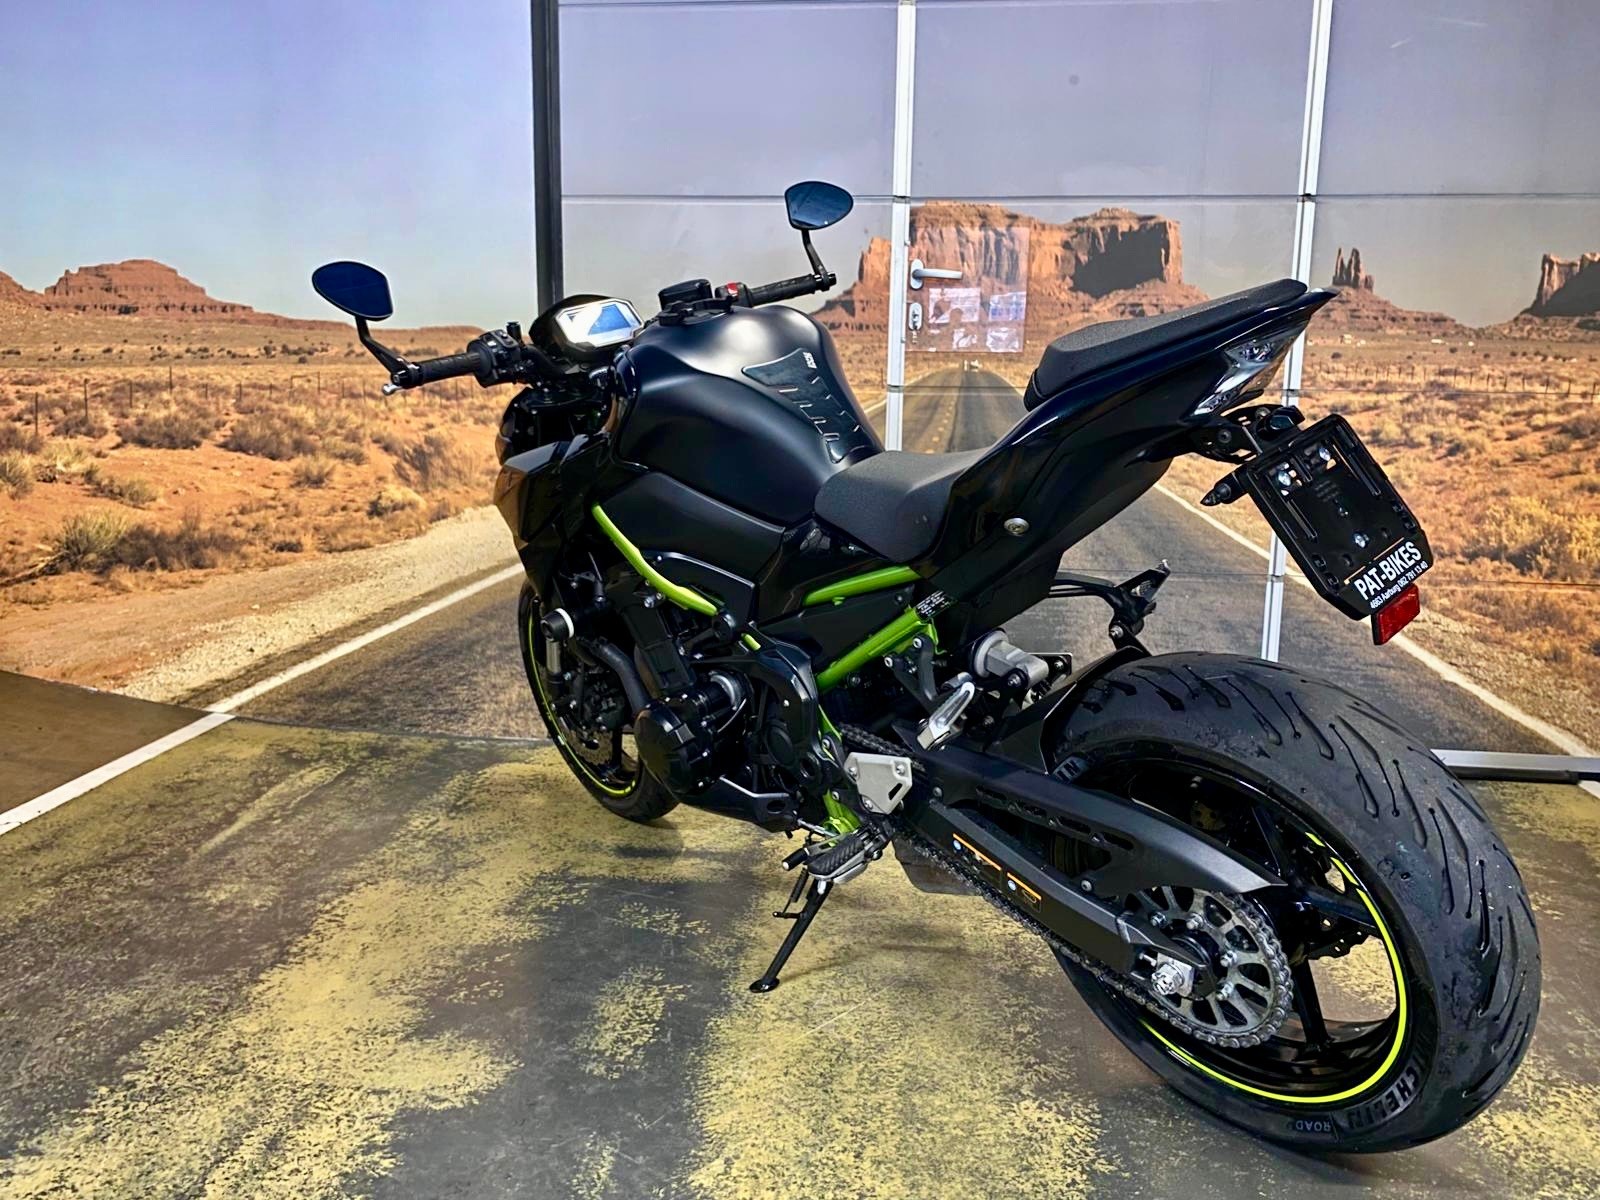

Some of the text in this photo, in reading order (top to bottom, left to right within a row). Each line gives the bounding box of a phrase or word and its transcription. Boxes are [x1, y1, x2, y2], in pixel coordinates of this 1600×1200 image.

[1353, 541, 1422, 600] PAT-BIKES
[1380, 584, 1401, 600] Aarburg
[1295, 1119, 1331, 1132] ROAD
